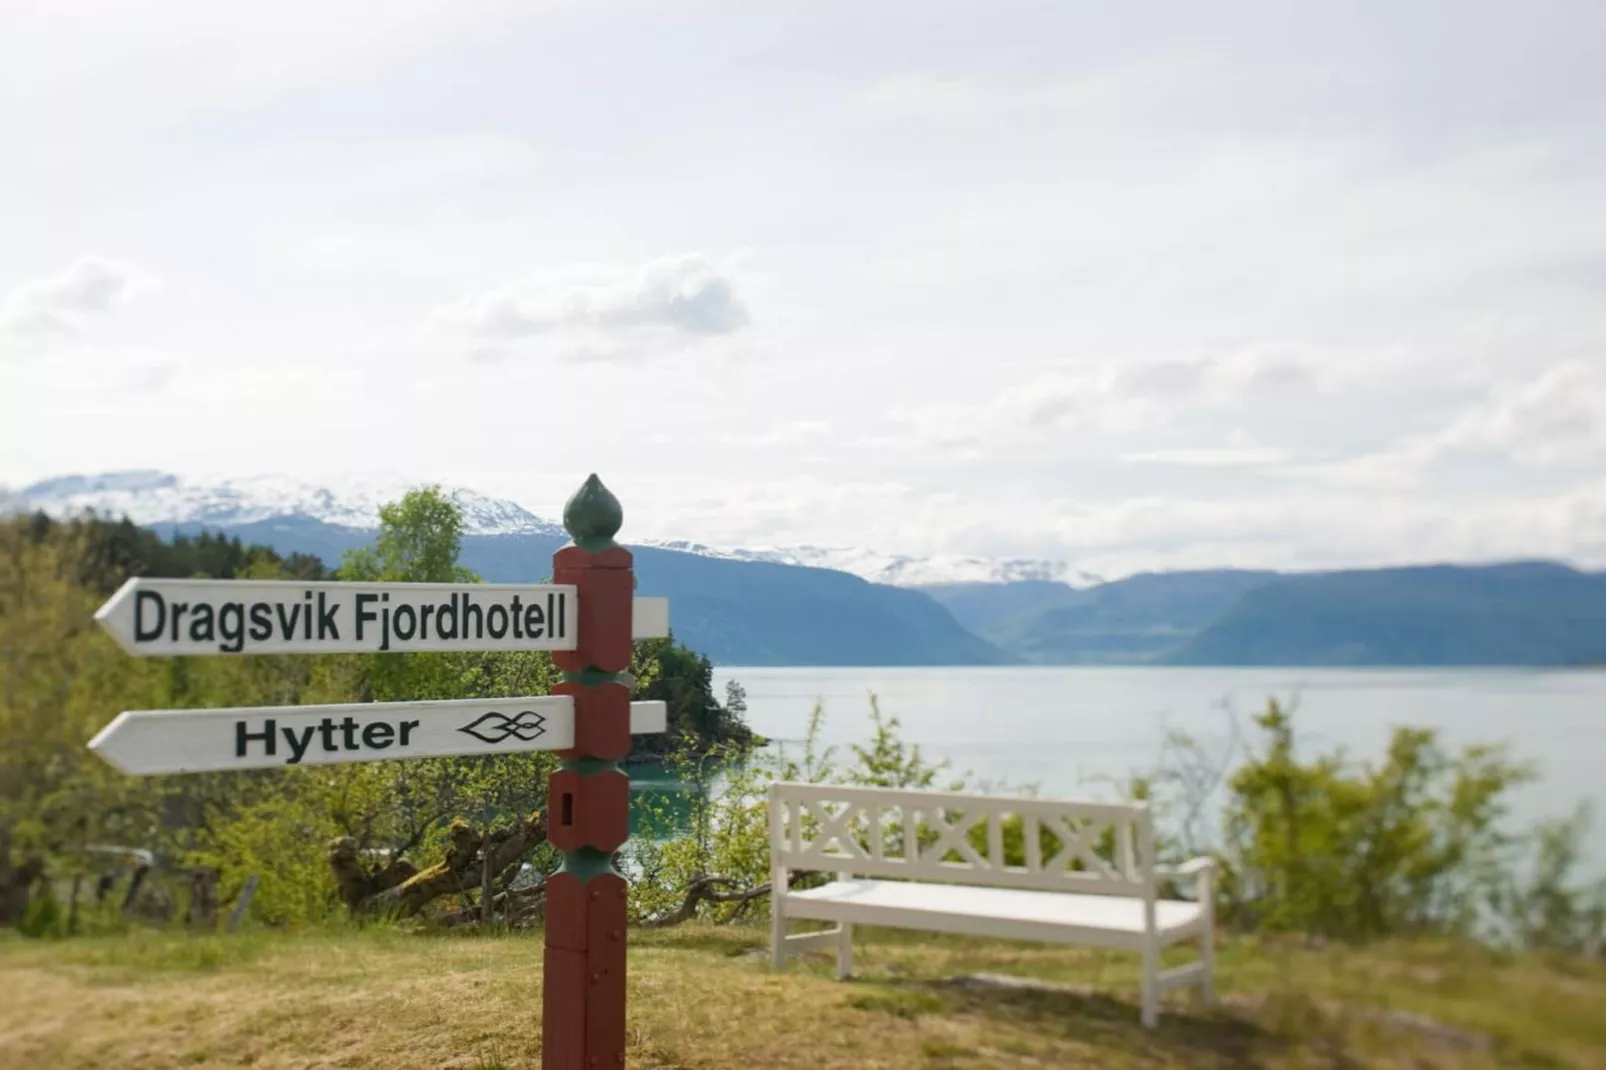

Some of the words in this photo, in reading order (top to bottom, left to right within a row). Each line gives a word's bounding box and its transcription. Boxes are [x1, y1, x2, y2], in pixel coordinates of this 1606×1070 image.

[133, 589, 341, 654] Dragsvik
[355, 592, 566, 652] Fjordhotell
[235, 718, 420, 764] Hytter
